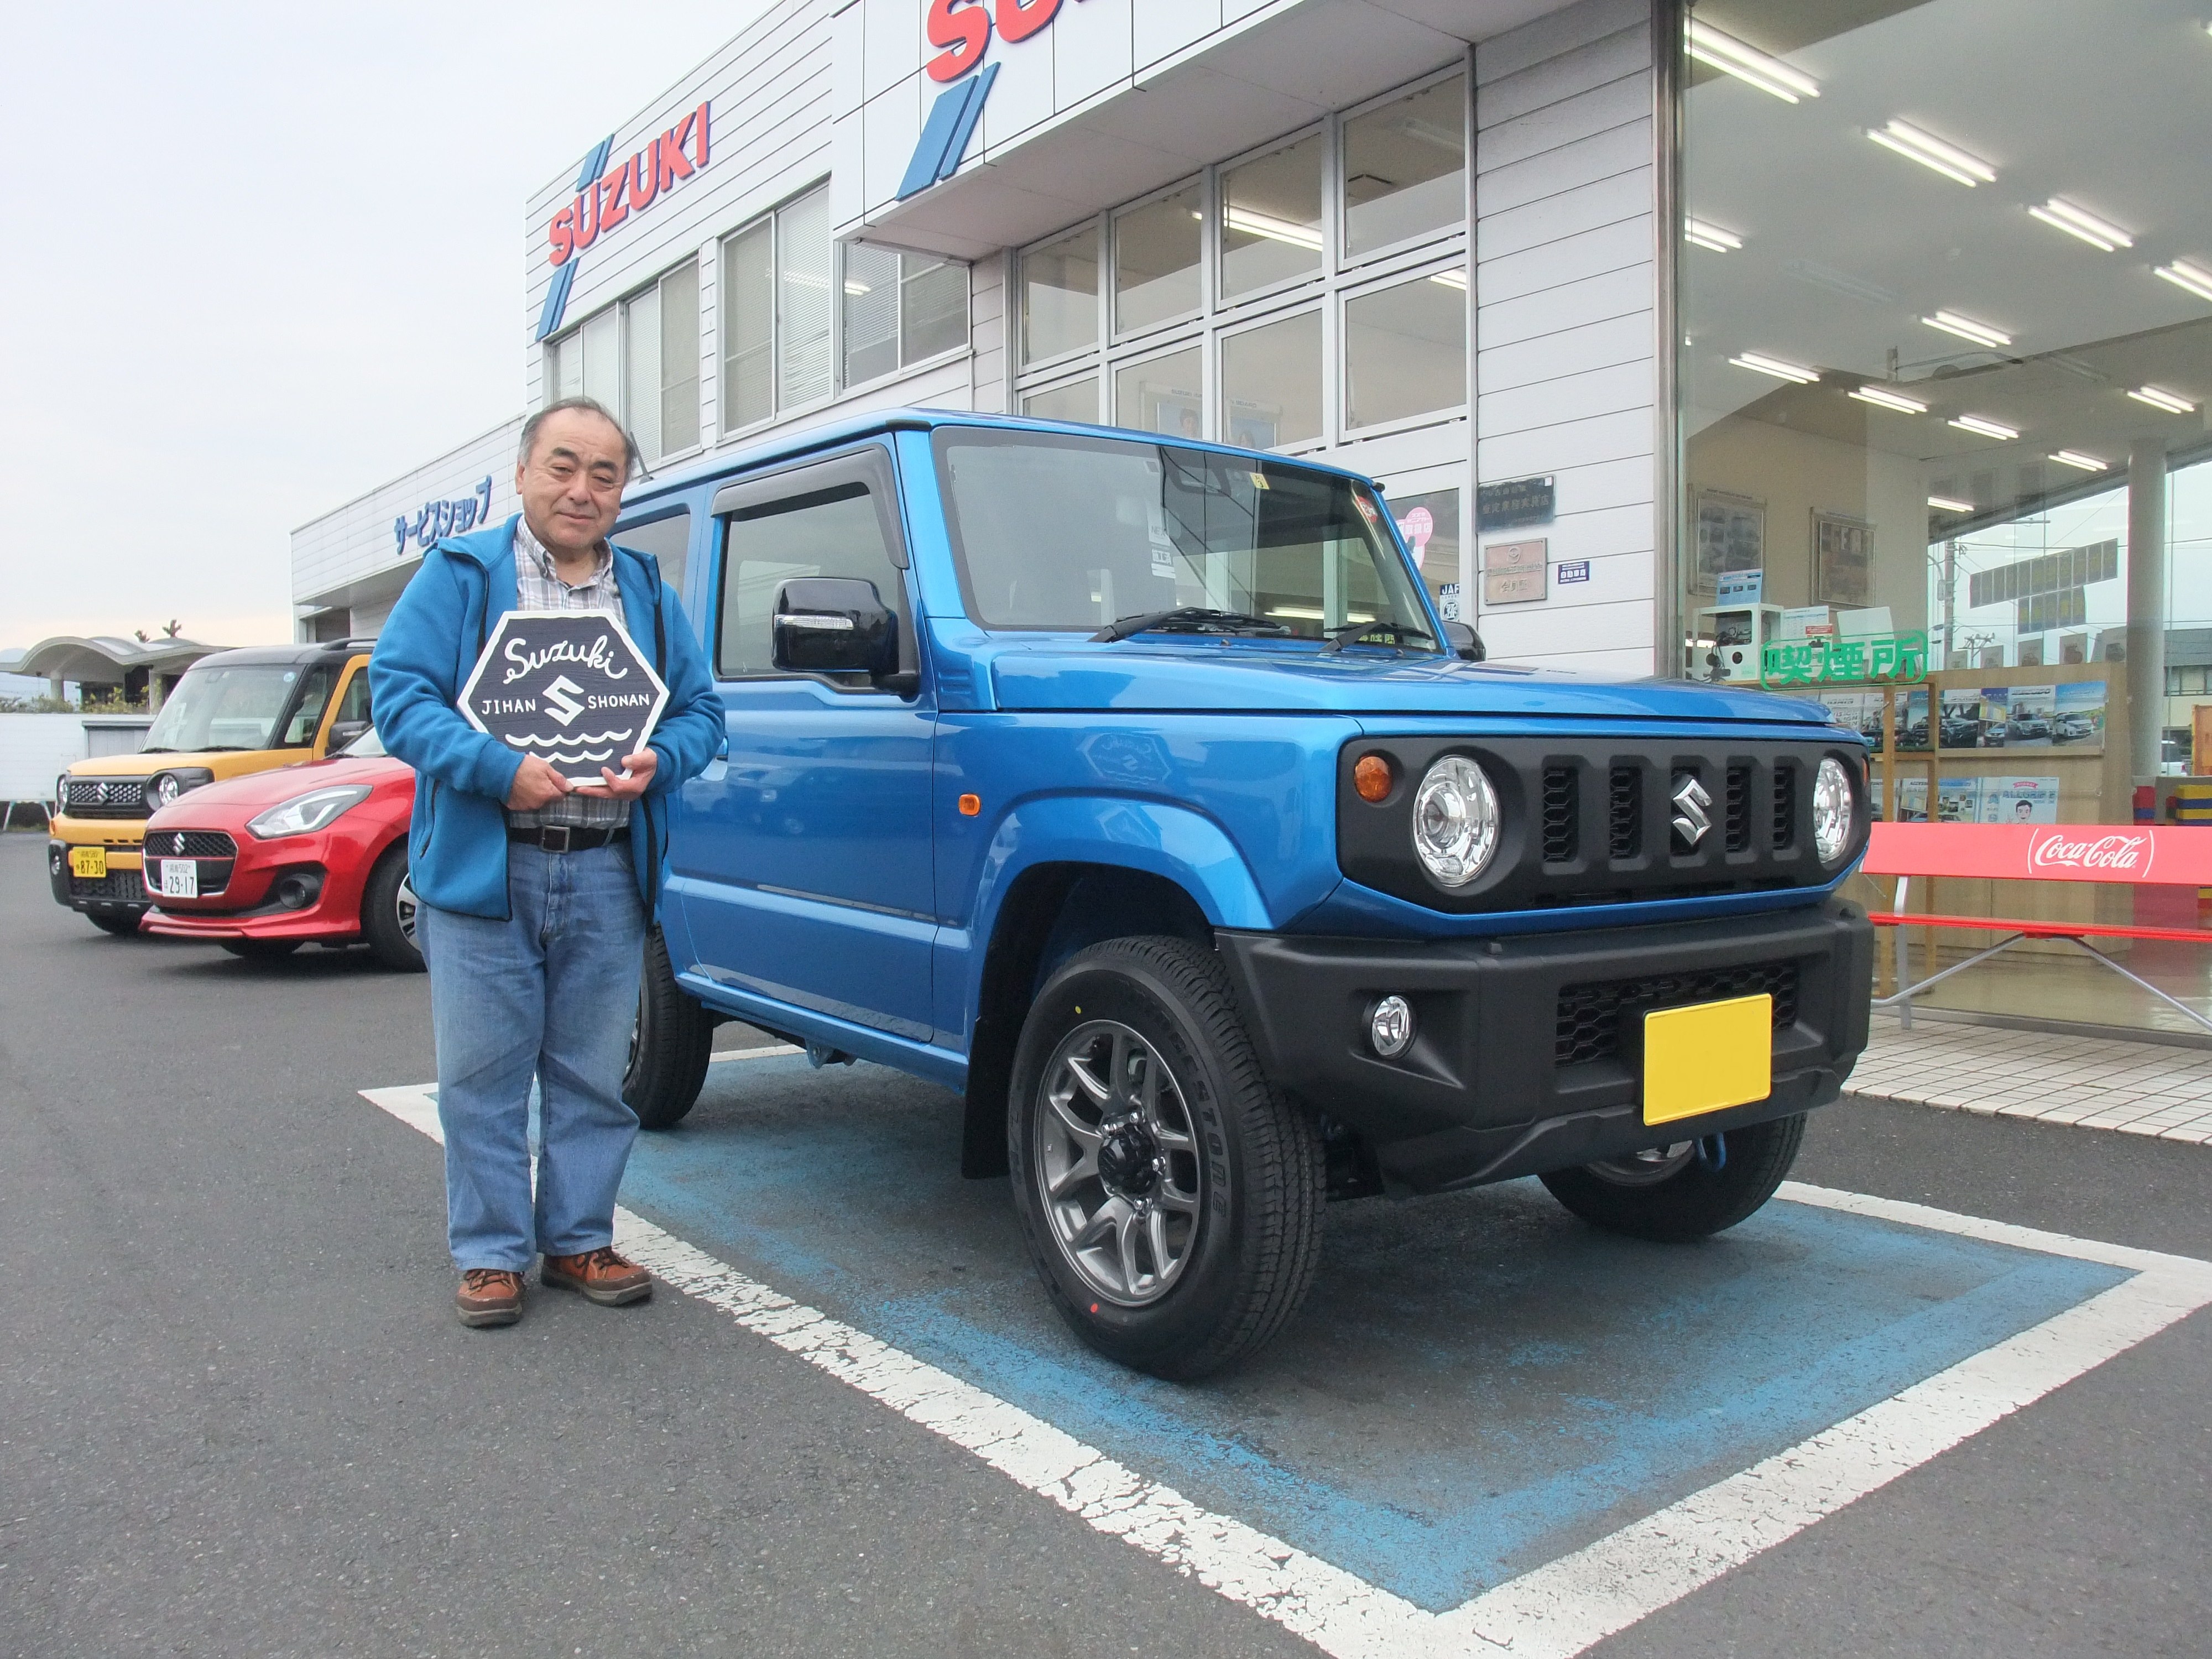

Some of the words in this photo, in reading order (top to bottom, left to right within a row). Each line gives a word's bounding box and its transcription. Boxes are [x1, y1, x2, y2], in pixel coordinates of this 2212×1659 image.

[549, 101, 711, 267] SUZUKI
[394, 473, 492, 555] サービスショップ
[1442, 584, 1460, 594] JAF
[503, 635, 628, 684] Suzuki
[1767, 637, 1919, 685] 喫煙所
[482, 698, 536, 714] JIHAN
[587, 693, 650, 709] SHONAN
[2034, 834, 2147, 869] Coca-Cola
